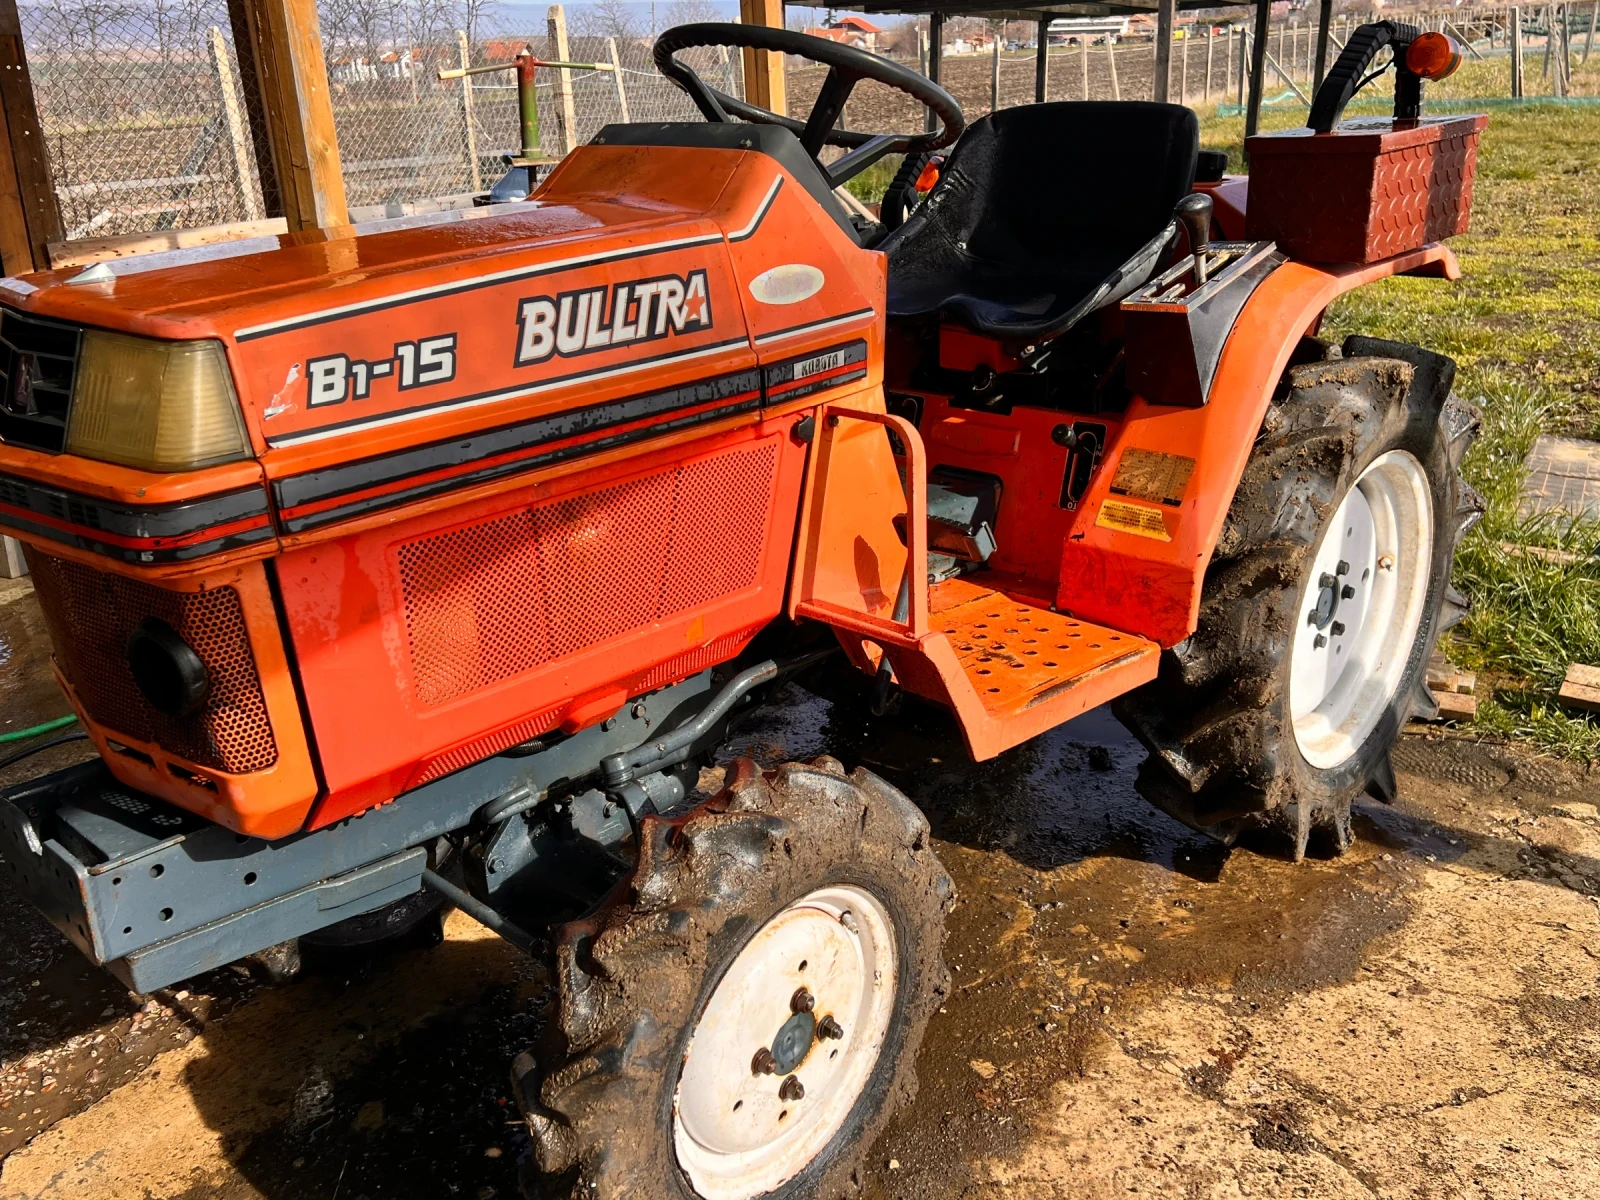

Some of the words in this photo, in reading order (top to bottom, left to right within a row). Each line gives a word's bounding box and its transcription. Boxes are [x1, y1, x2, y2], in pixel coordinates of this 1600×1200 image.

[516, 271, 711, 365] BULLTRA
[308, 335, 455, 407] B1-15
[801, 353, 838, 377] KUBOTA
